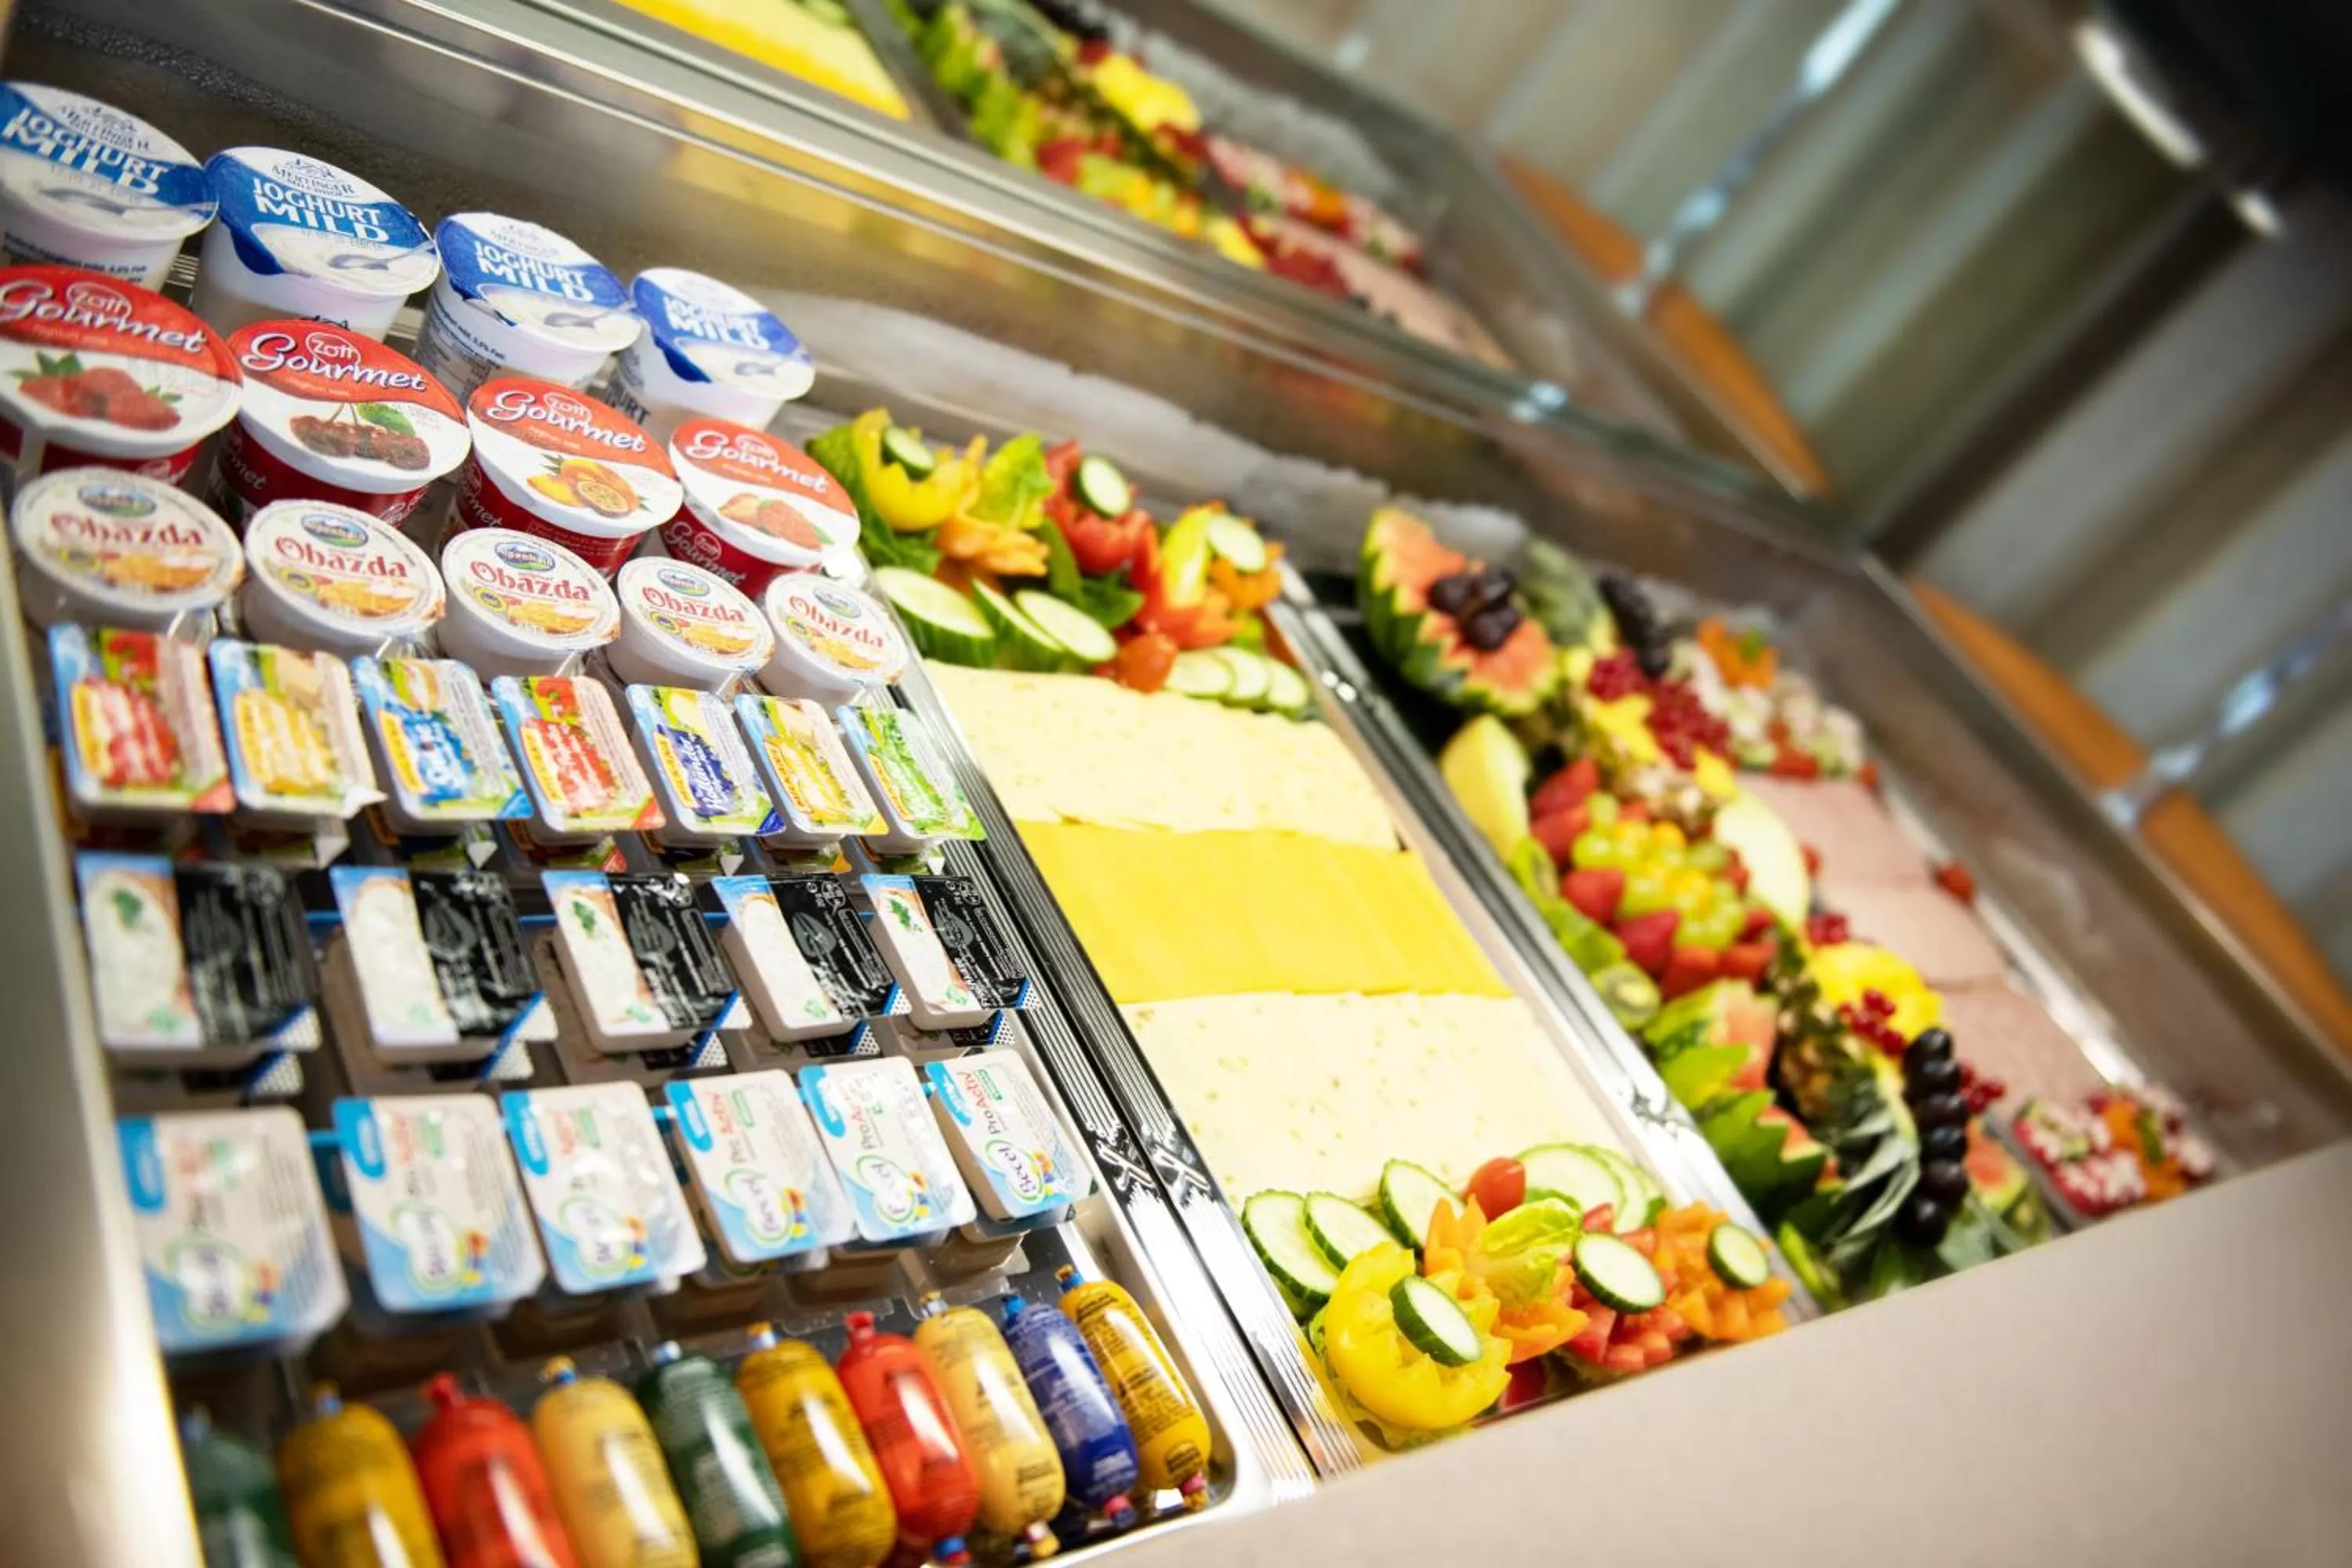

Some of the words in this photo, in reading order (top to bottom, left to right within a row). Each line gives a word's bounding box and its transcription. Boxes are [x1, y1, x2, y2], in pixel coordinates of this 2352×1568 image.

[2, 119, 159, 194] MILD
[19, 107, 168, 181] JOGHURT
[252, 176, 382, 227] JOGHURT
[254, 194, 390, 242] MILD
[474, 240, 588, 287] JOGHURT
[477, 256, 594, 303] MILD
[0, 278, 208, 354] Gourmet
[240, 332, 428, 391] Gourmet
[310, 339, 355, 361] Zott
[486, 390, 647, 452] Gourmet
[685, 430, 829, 494] Gourmet
[274, 536, 408, 578] Obazda
[470, 560, 590, 601] Obazda
[642, 586, 745, 622] Obazda
[789, 595, 884, 648] Obazda
[956, 1071, 1002, 1135] ProActiv
[997, 1146, 1036, 1194] Becel
